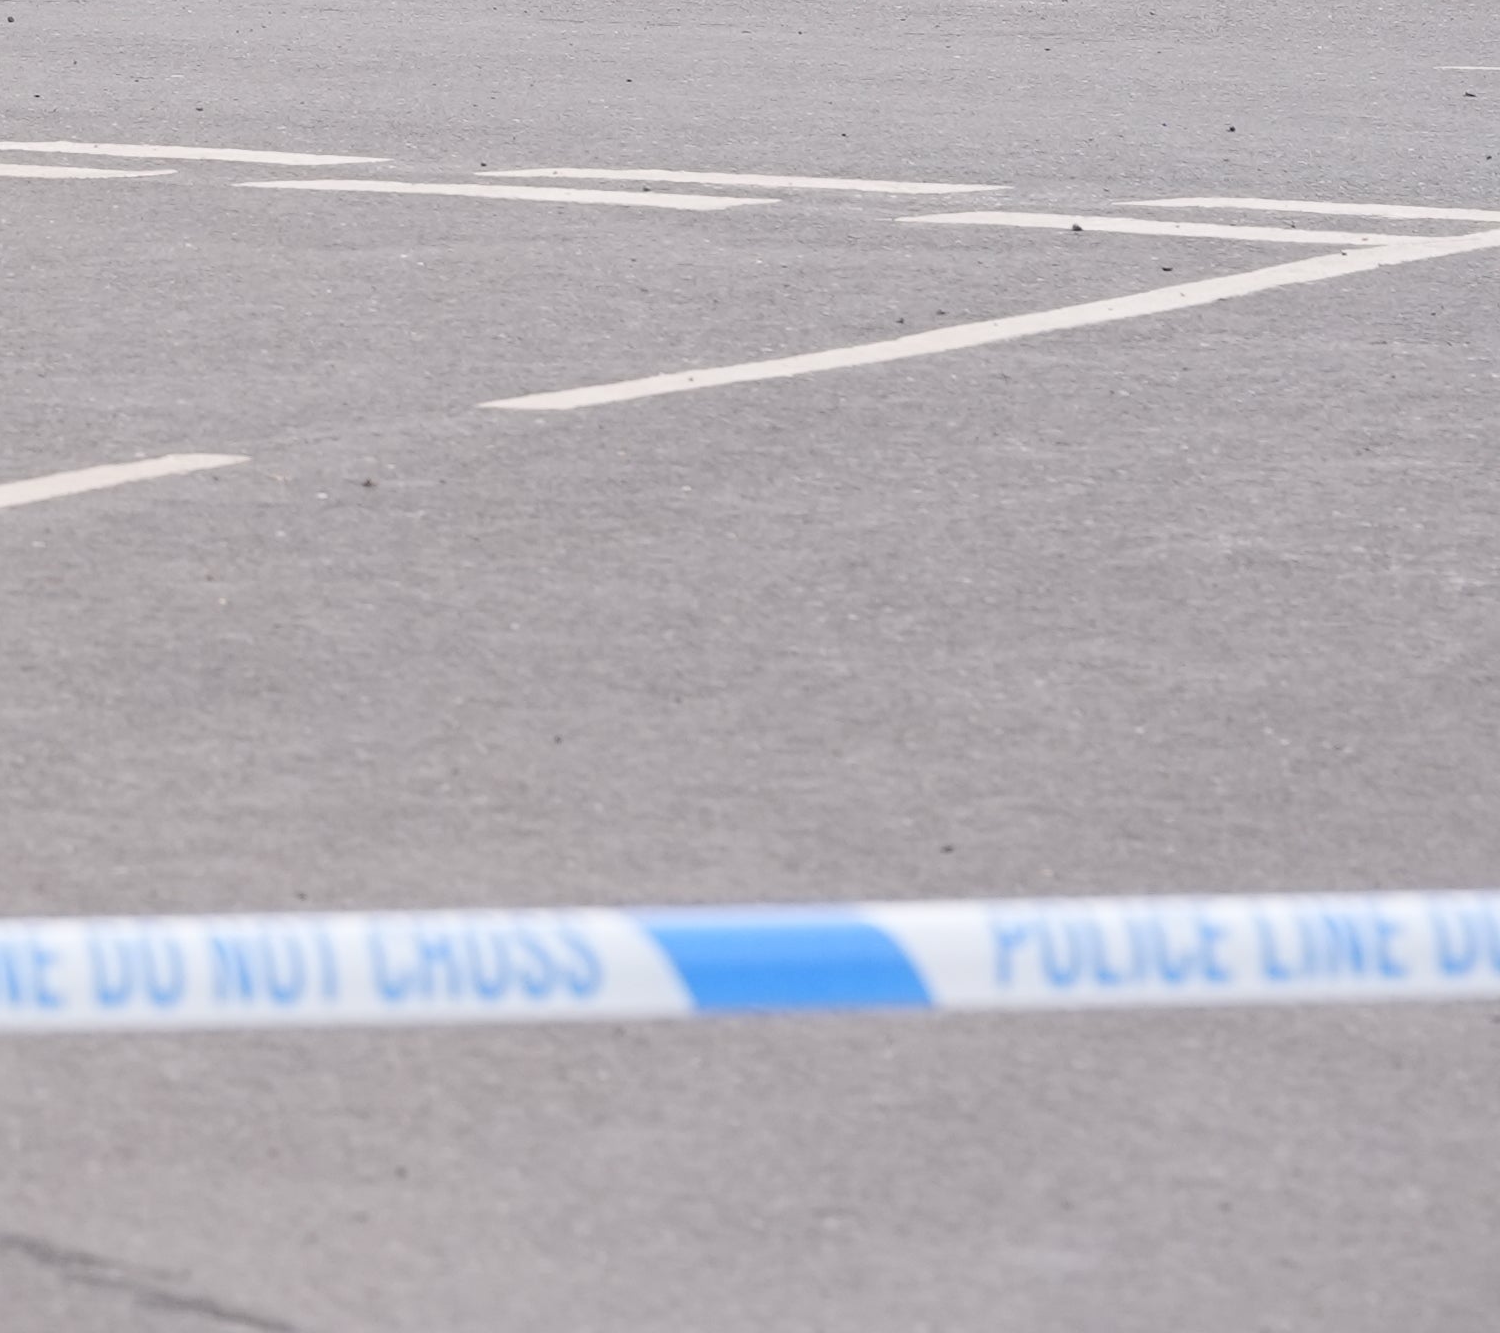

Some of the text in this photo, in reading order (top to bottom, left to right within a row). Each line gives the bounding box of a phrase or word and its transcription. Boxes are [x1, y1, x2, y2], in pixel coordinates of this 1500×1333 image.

[97, 930, 186, 1008] DO
[211, 927, 340, 1003] NOT
[372, 925, 604, 1002] CROSS
[1259, 910, 1404, 982] LINE
